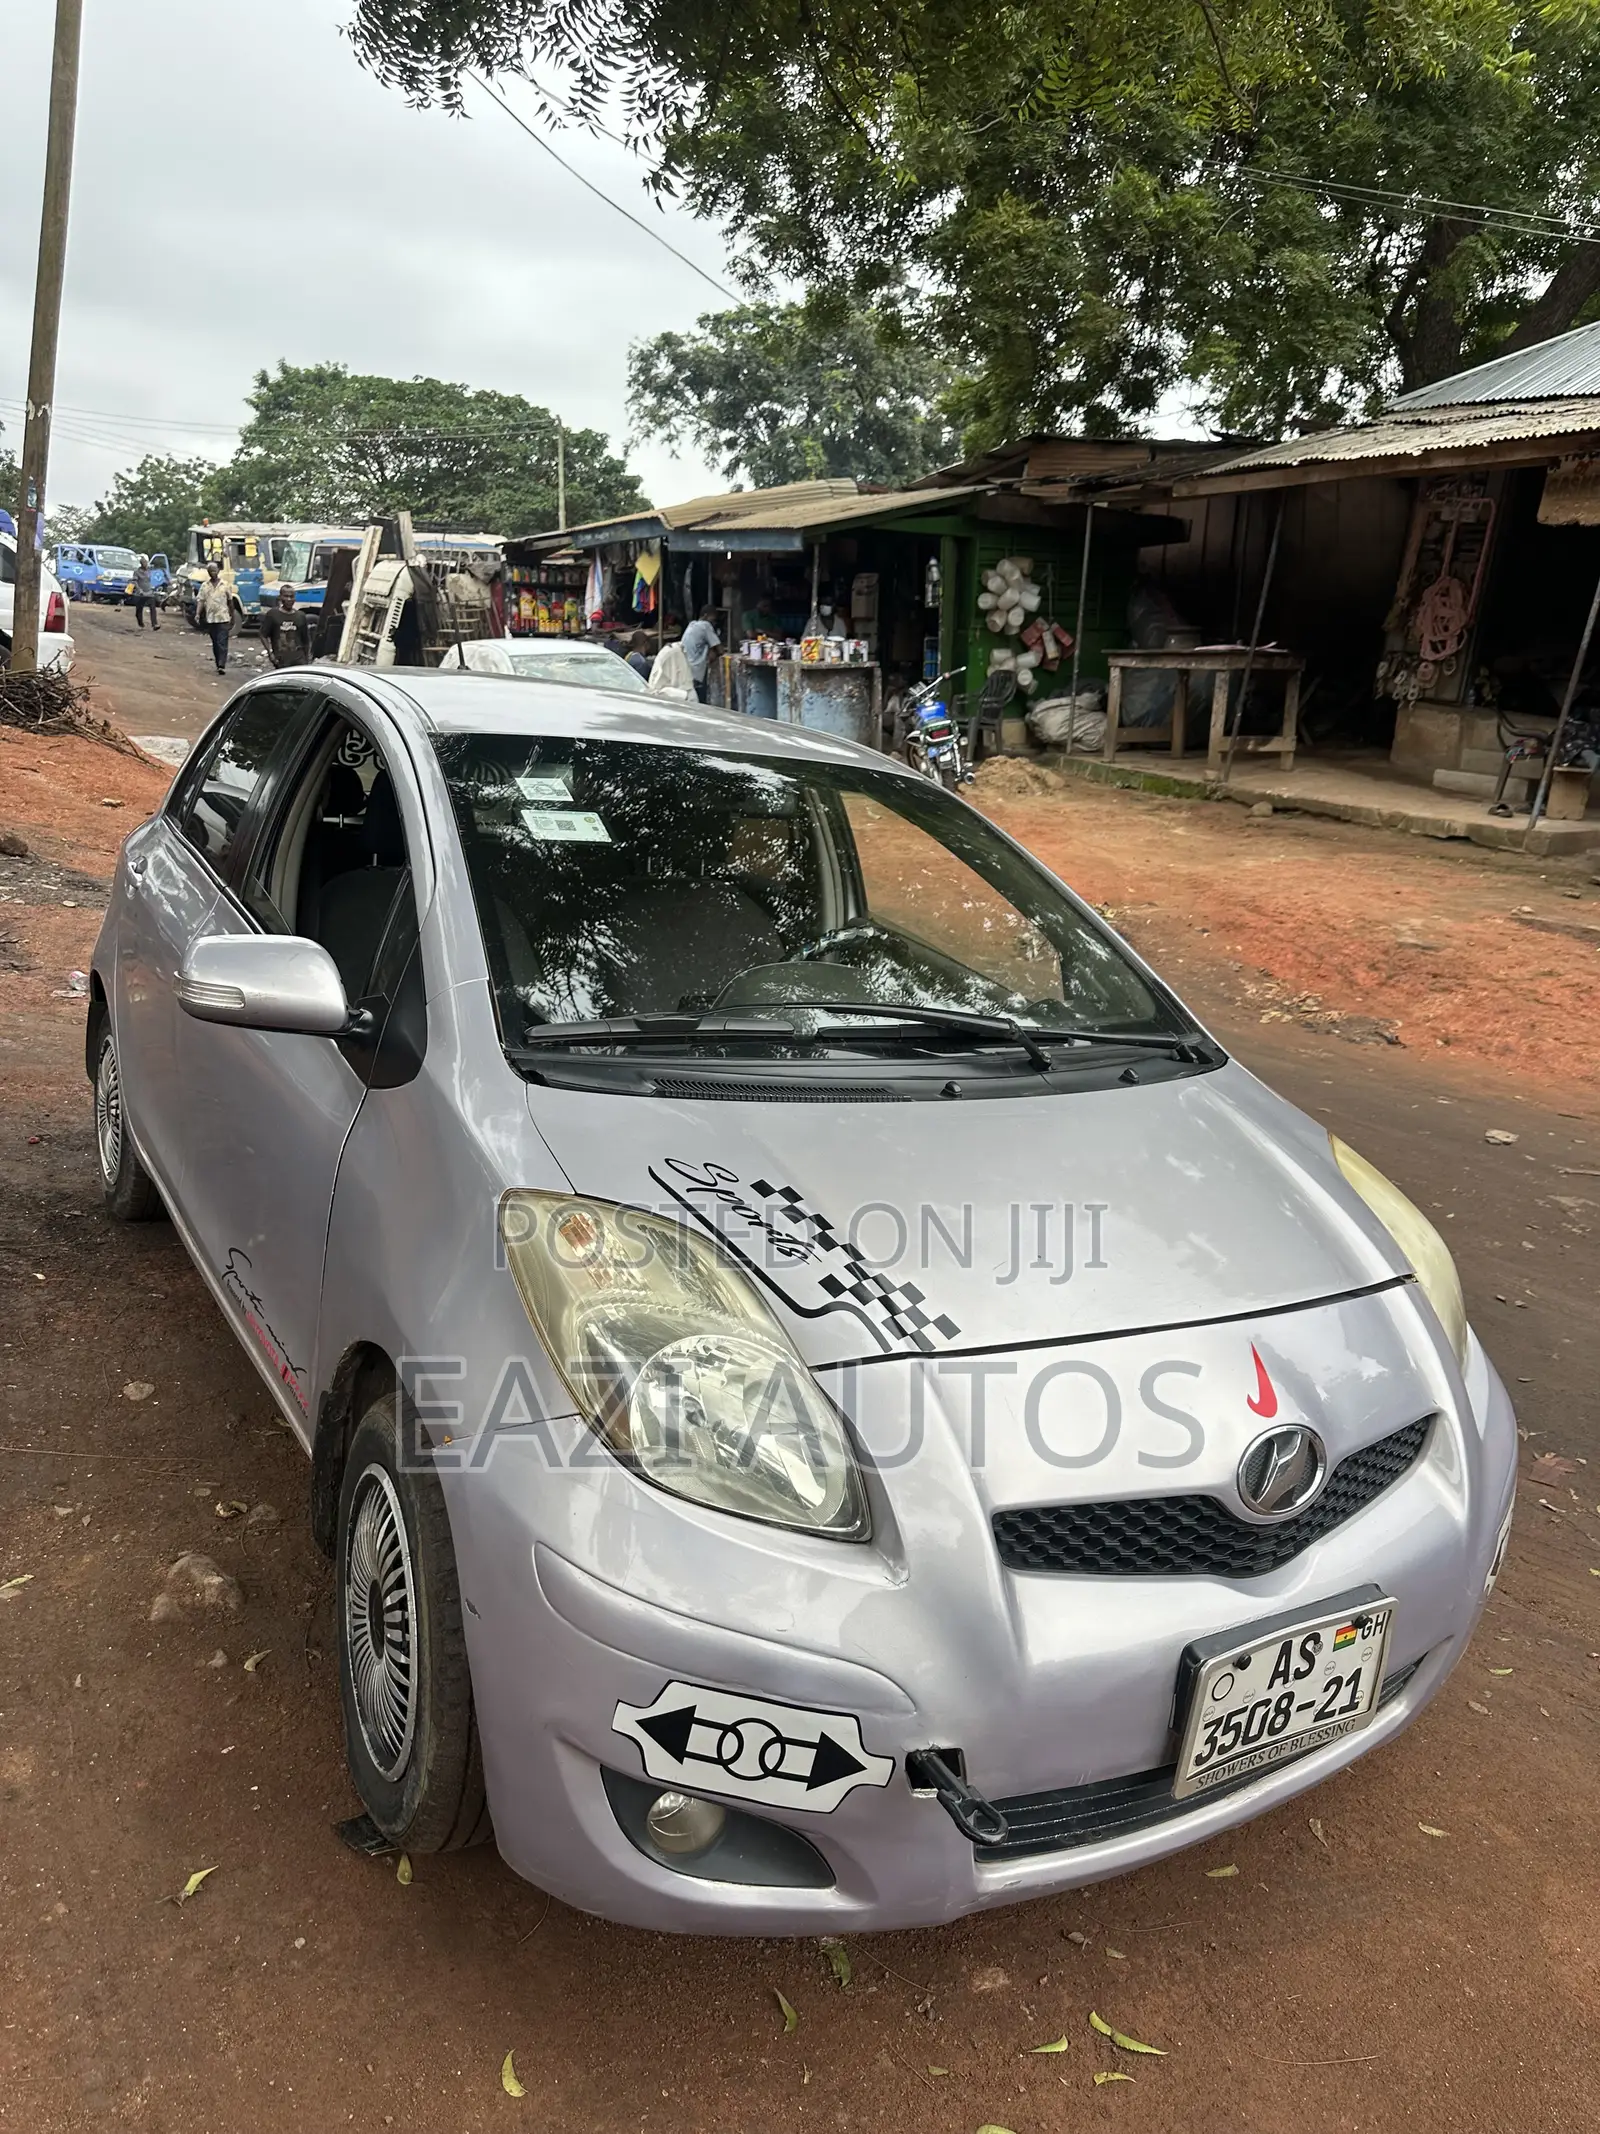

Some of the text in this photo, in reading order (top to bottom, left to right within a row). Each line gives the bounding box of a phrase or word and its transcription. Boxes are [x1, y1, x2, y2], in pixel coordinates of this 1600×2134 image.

[664, 1157, 822, 1265] Sports
[1267, 1632, 1321, 1690] AS
[1361, 1613, 1385, 1640] GH
[1195, 1667, 1362, 1766] 3508-21
[1196, 1719, 1356, 1789] SHOWERS OF BLESSING
